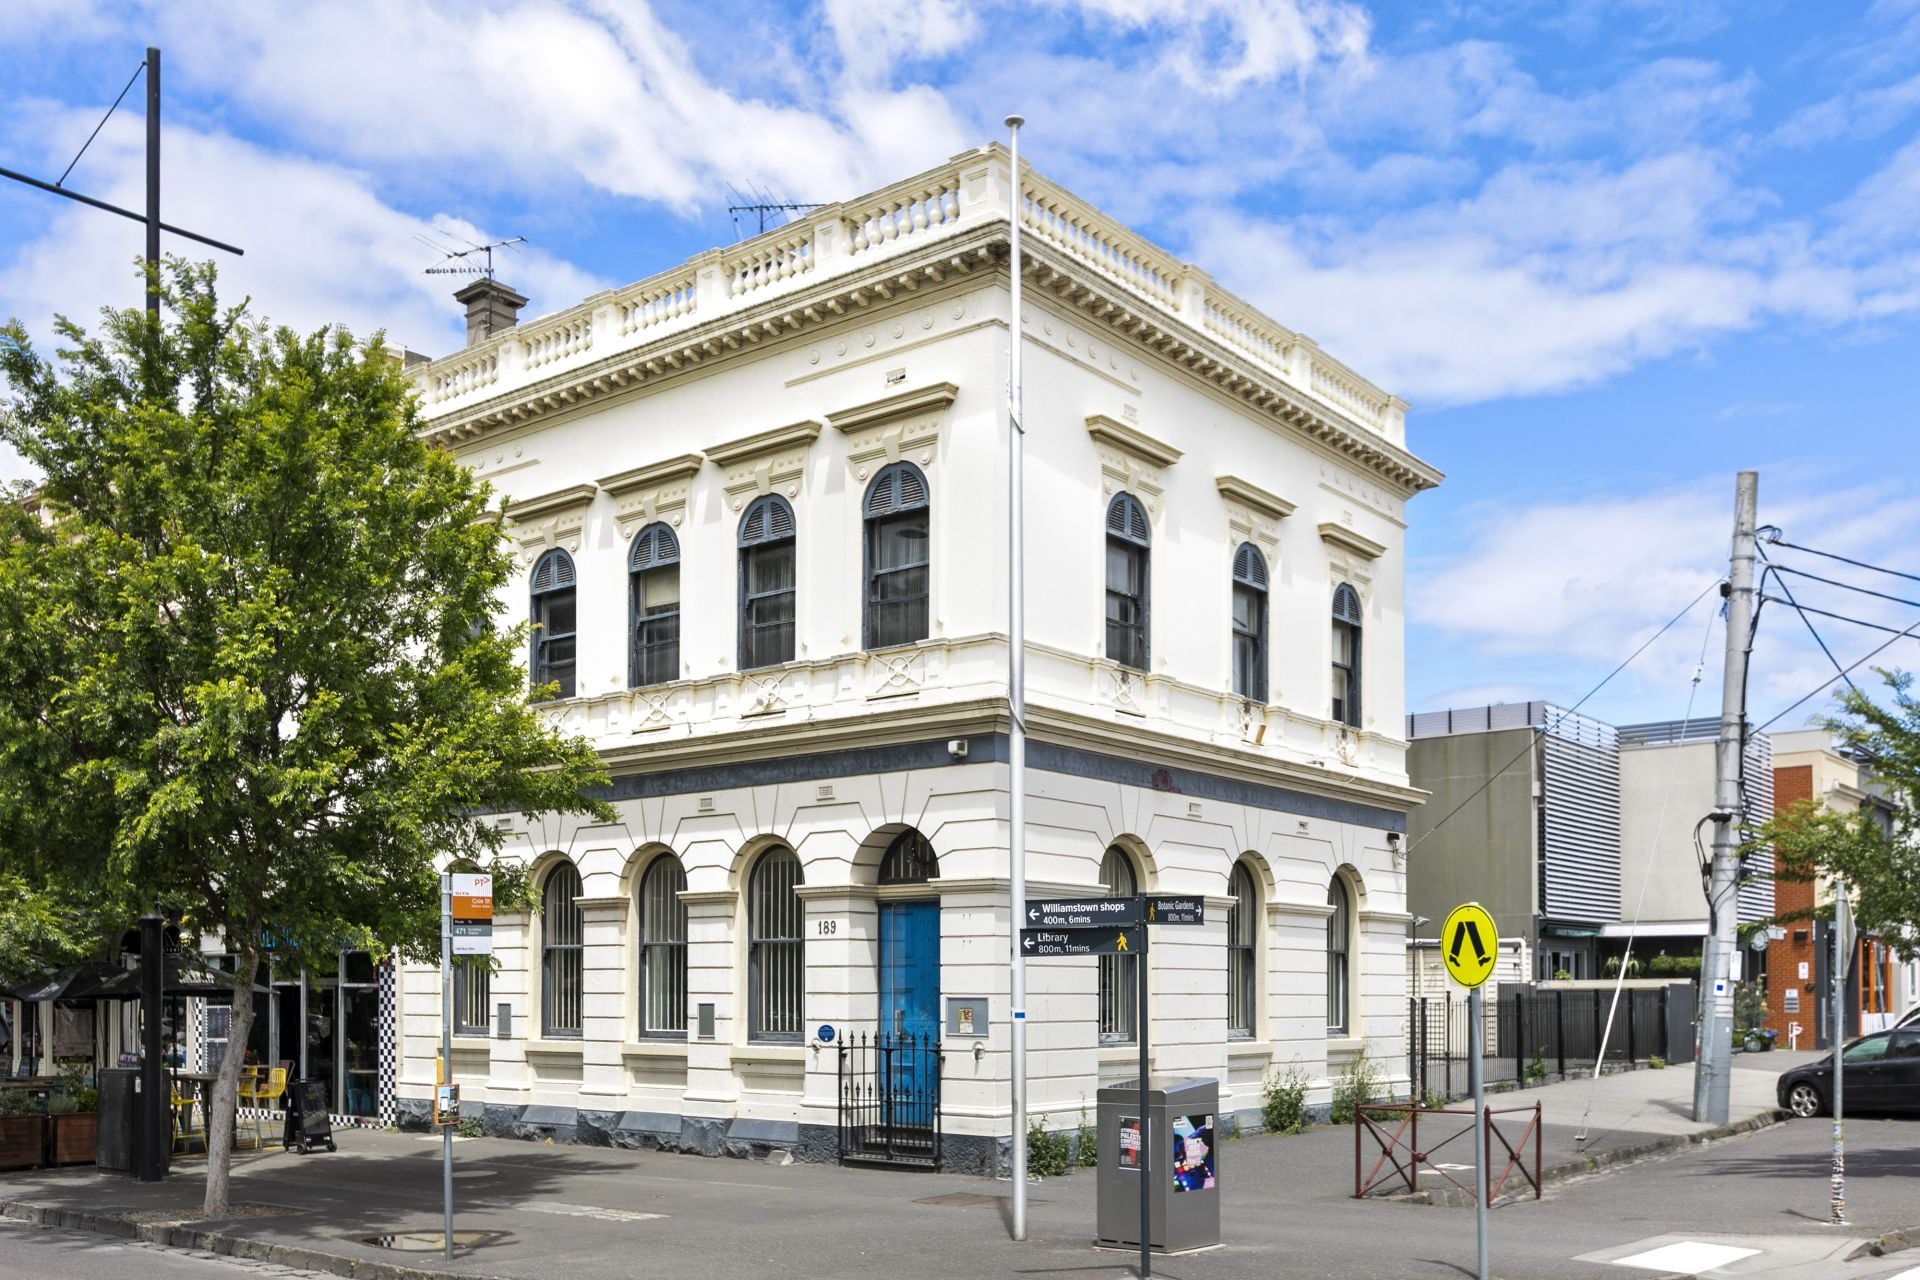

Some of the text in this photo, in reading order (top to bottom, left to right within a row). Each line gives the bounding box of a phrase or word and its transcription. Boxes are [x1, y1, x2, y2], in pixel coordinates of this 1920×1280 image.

[1042, 902, 1125, 913] Williamstown shops
[1158, 901, 1195, 910] Botanic Gardens
[1043, 915, 1091, 925] 400m, 6mins
[818, 920, 836, 935] 189
[1037, 933, 1069, 944] Library
[1038, 944, 1090, 954] 800m, 11mins
